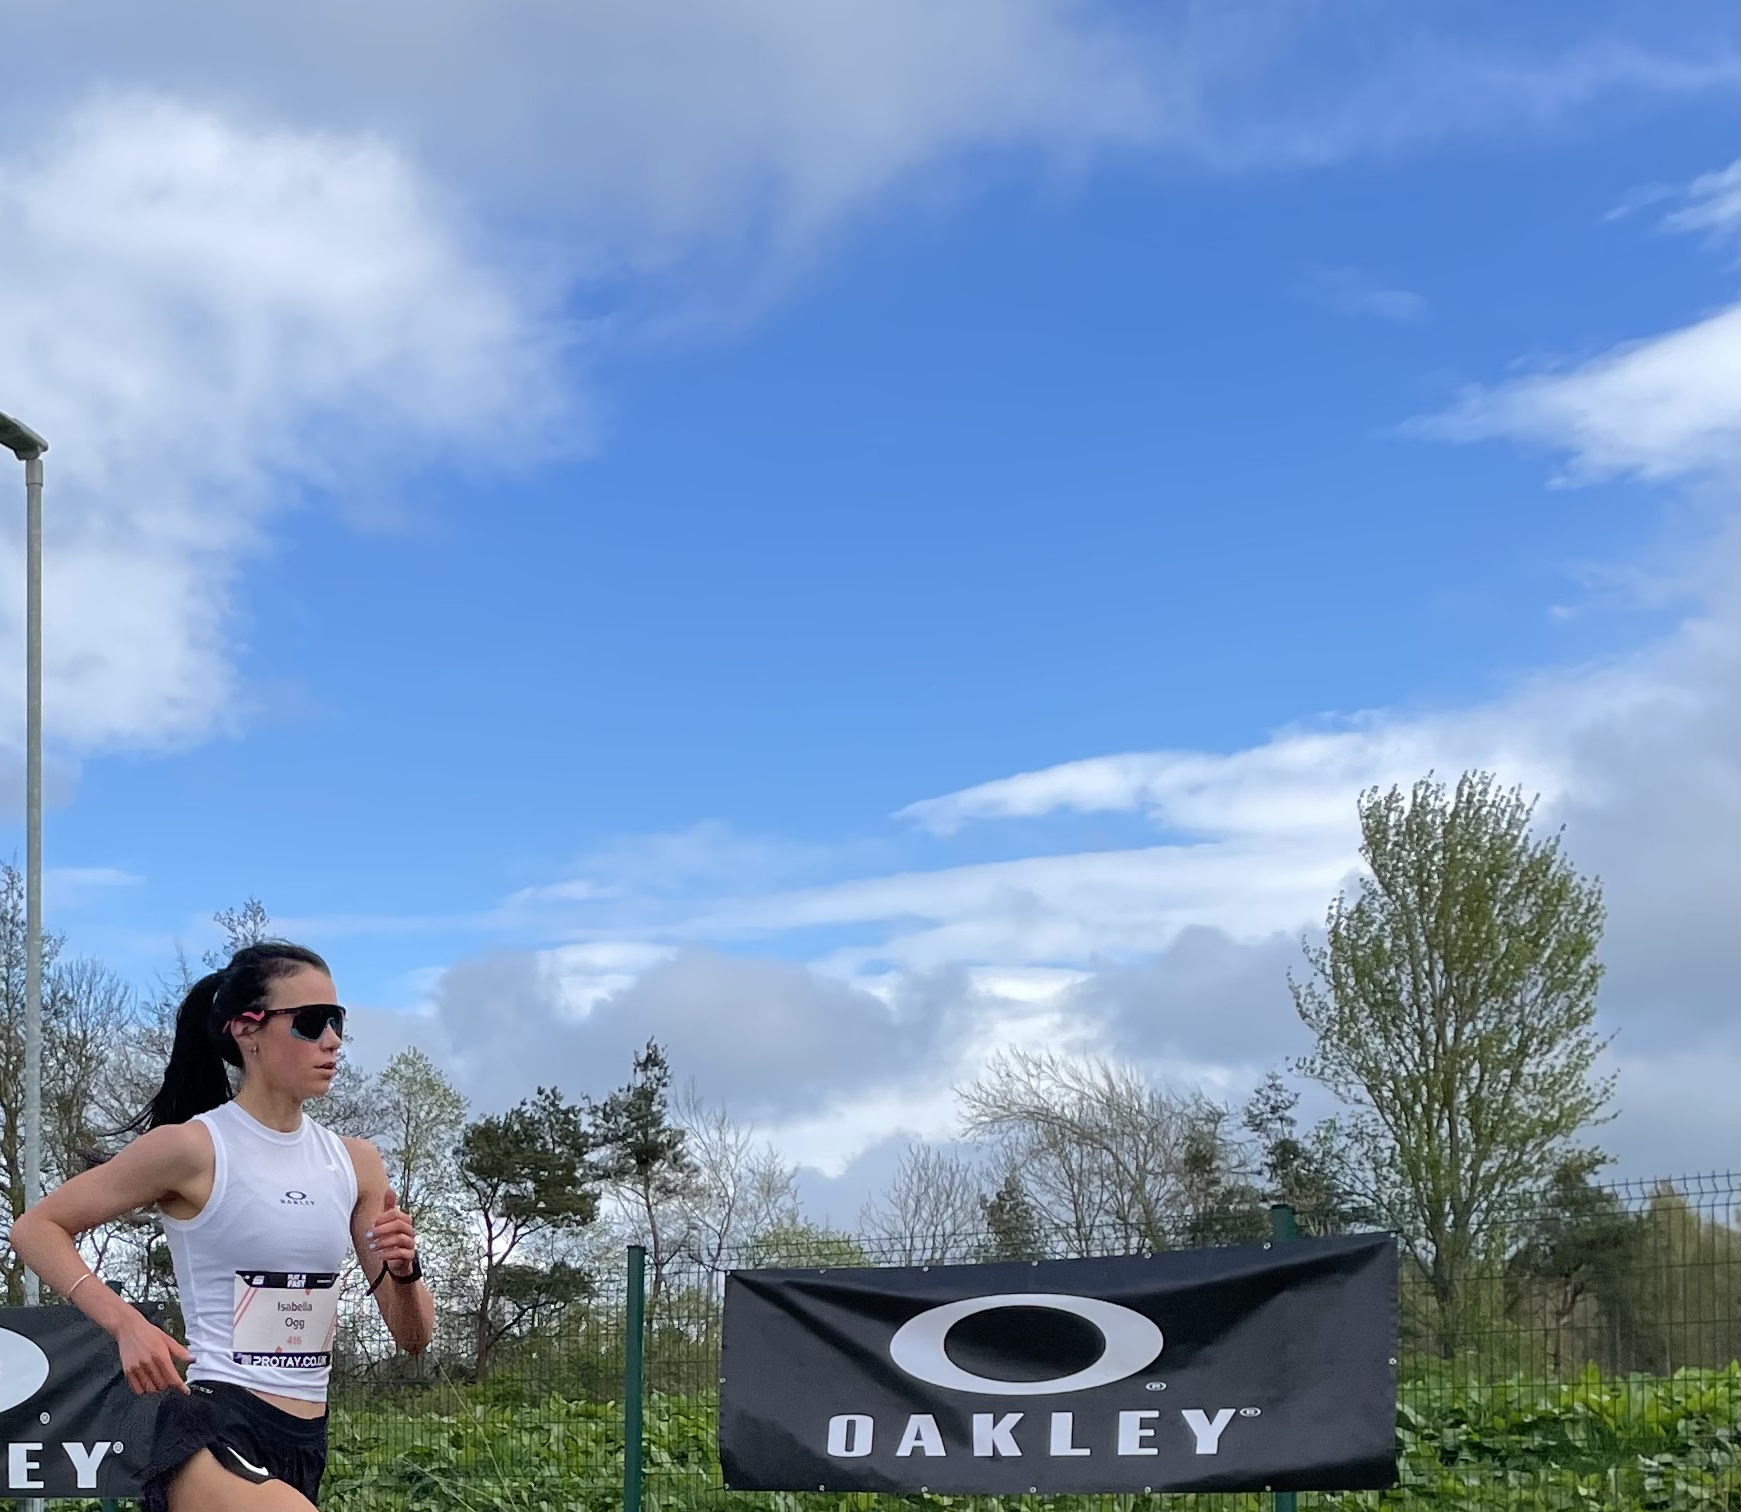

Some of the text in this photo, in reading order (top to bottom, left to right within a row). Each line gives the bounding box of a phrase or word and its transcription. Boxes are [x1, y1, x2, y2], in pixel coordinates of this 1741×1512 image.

[277, 1301, 313, 1311] Isabella
[285, 1317, 305, 1330] Ogg
[827, 1408, 1235, 1457] OAKLEY
